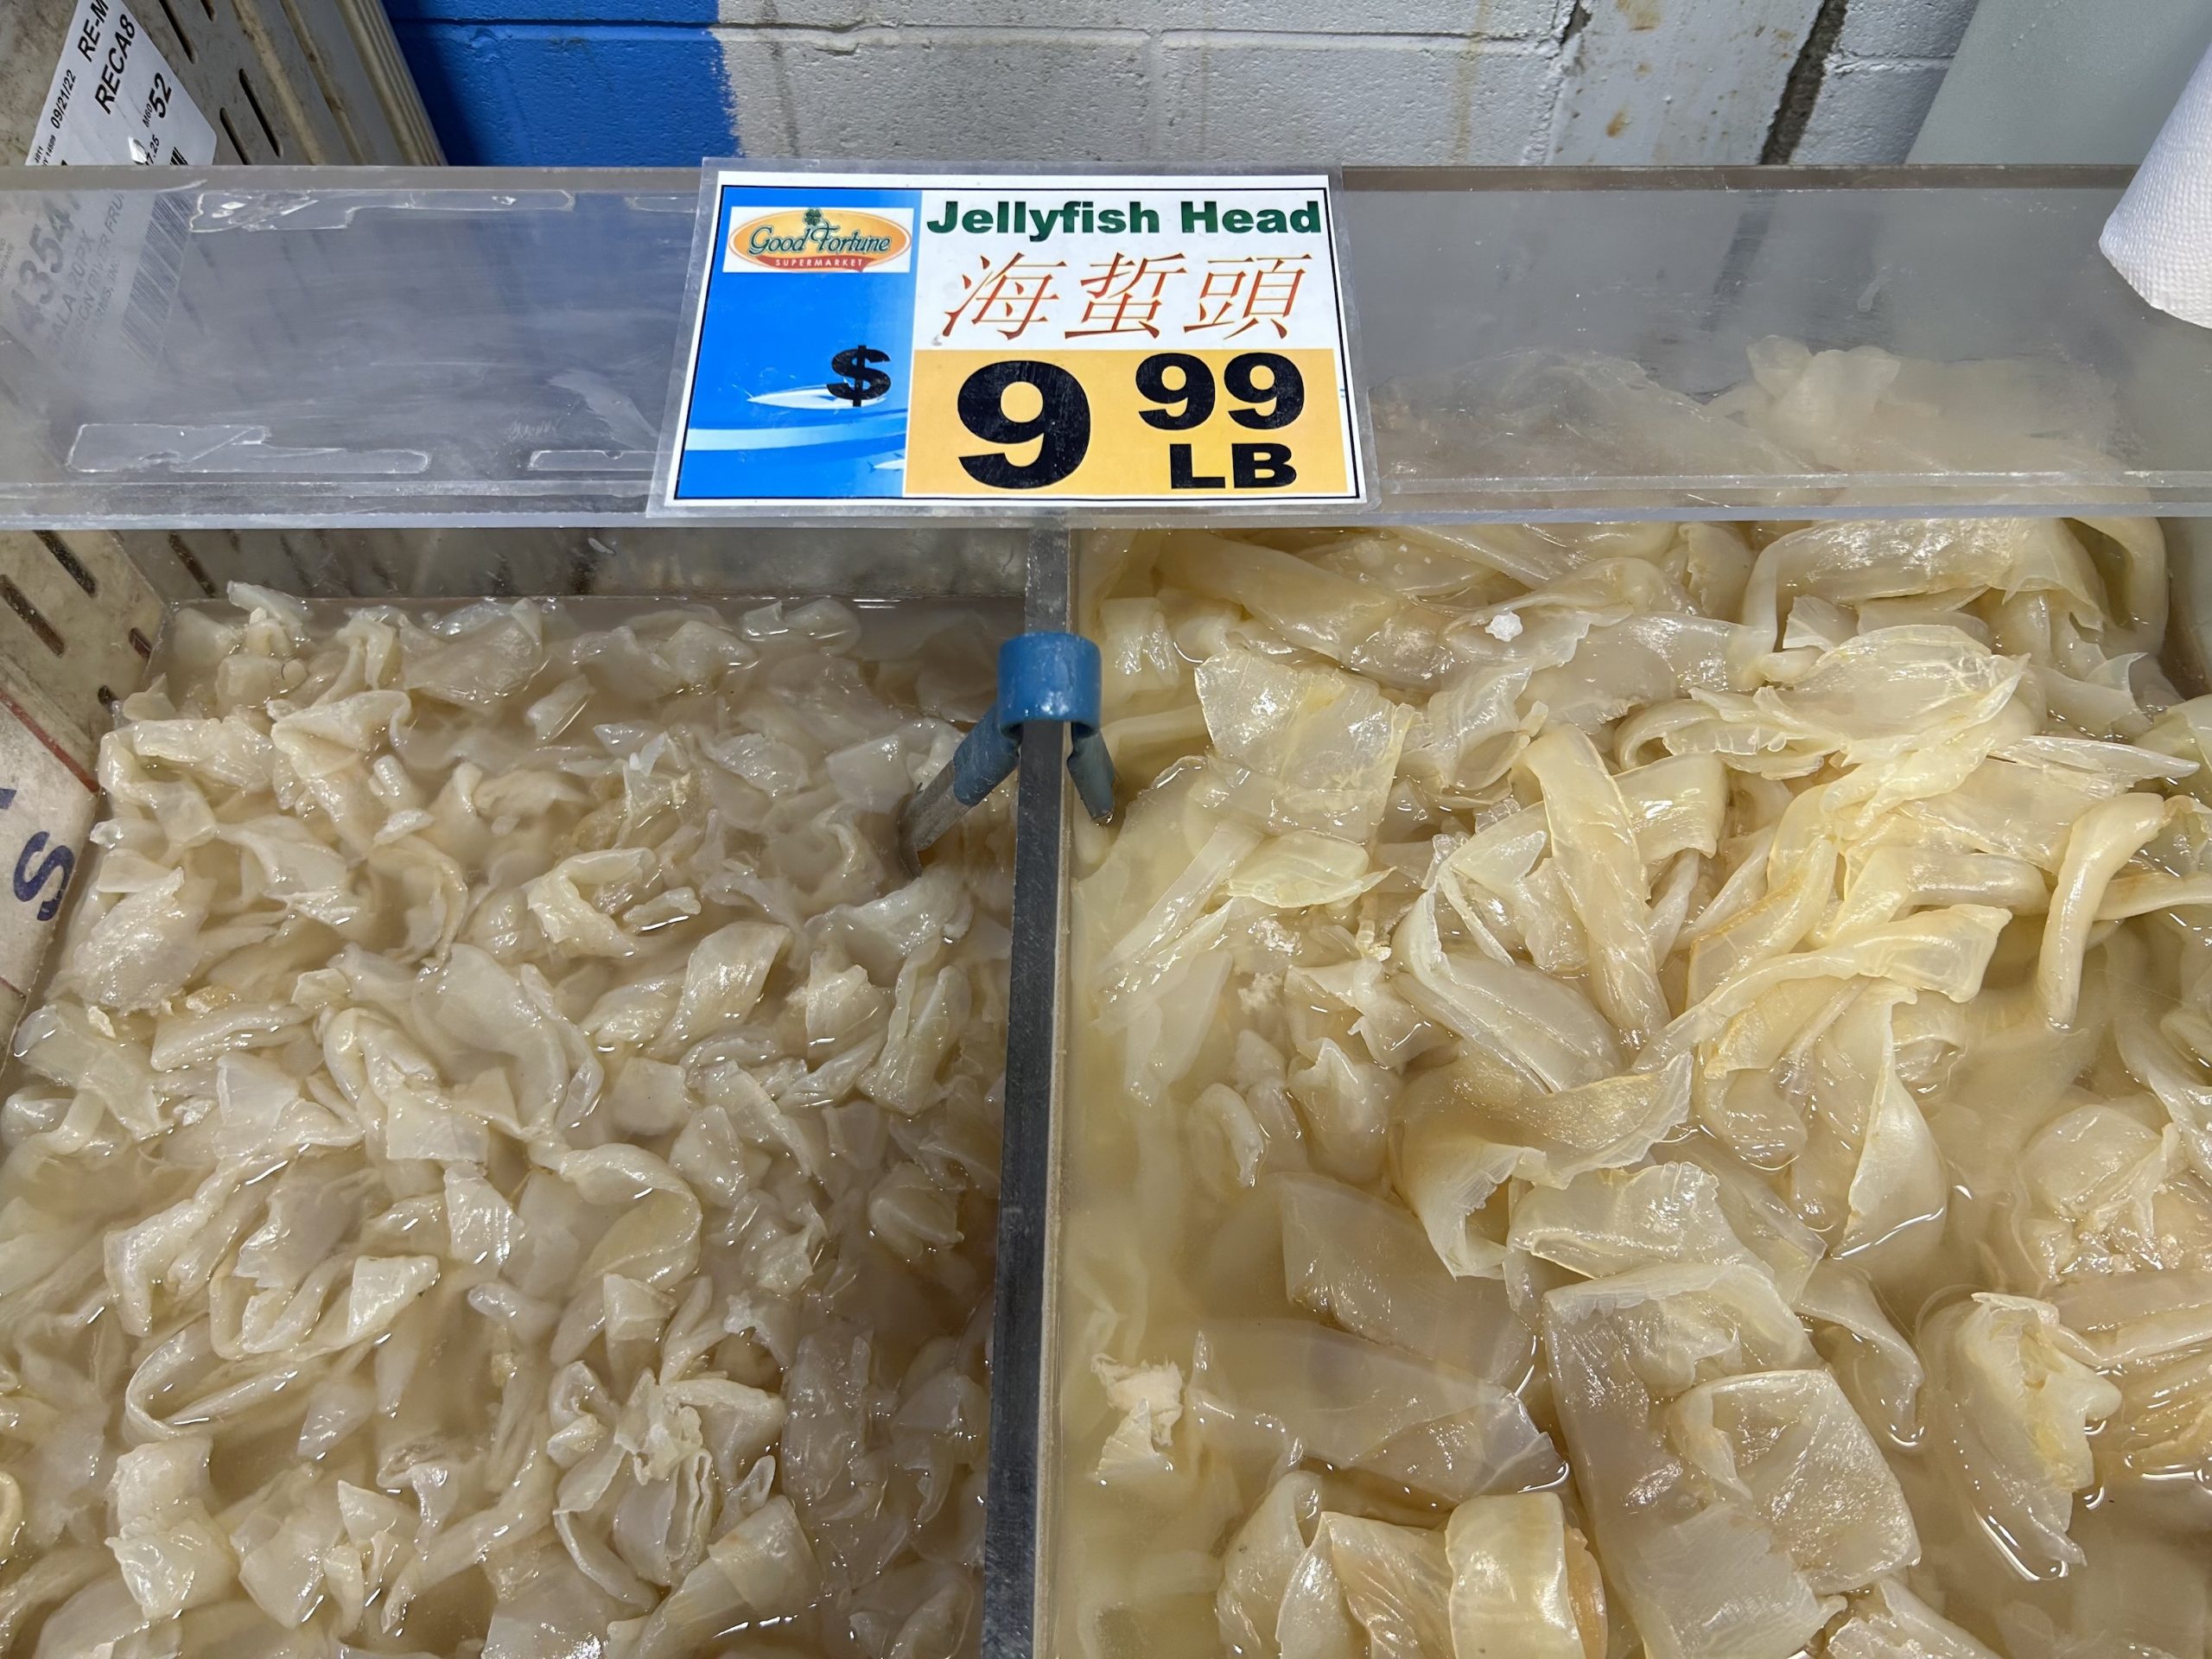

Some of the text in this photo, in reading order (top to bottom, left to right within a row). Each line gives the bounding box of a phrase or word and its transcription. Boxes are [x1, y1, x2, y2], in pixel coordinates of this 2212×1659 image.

[94, 14, 135, 115] RECA8
[50, 69, 76, 129] 09/21/22
[149, 73, 172, 118] 52
[748, 222, 892, 255] Good Fortune
[927, 200, 1321, 241] Jellyfish Head
[775, 258, 864, 267] SUPERMARKET
[942, 252, 1313, 340] 海蜇頭
[826, 345, 1306, 490] $ 9 99
[1170, 443, 1298, 489] LB
